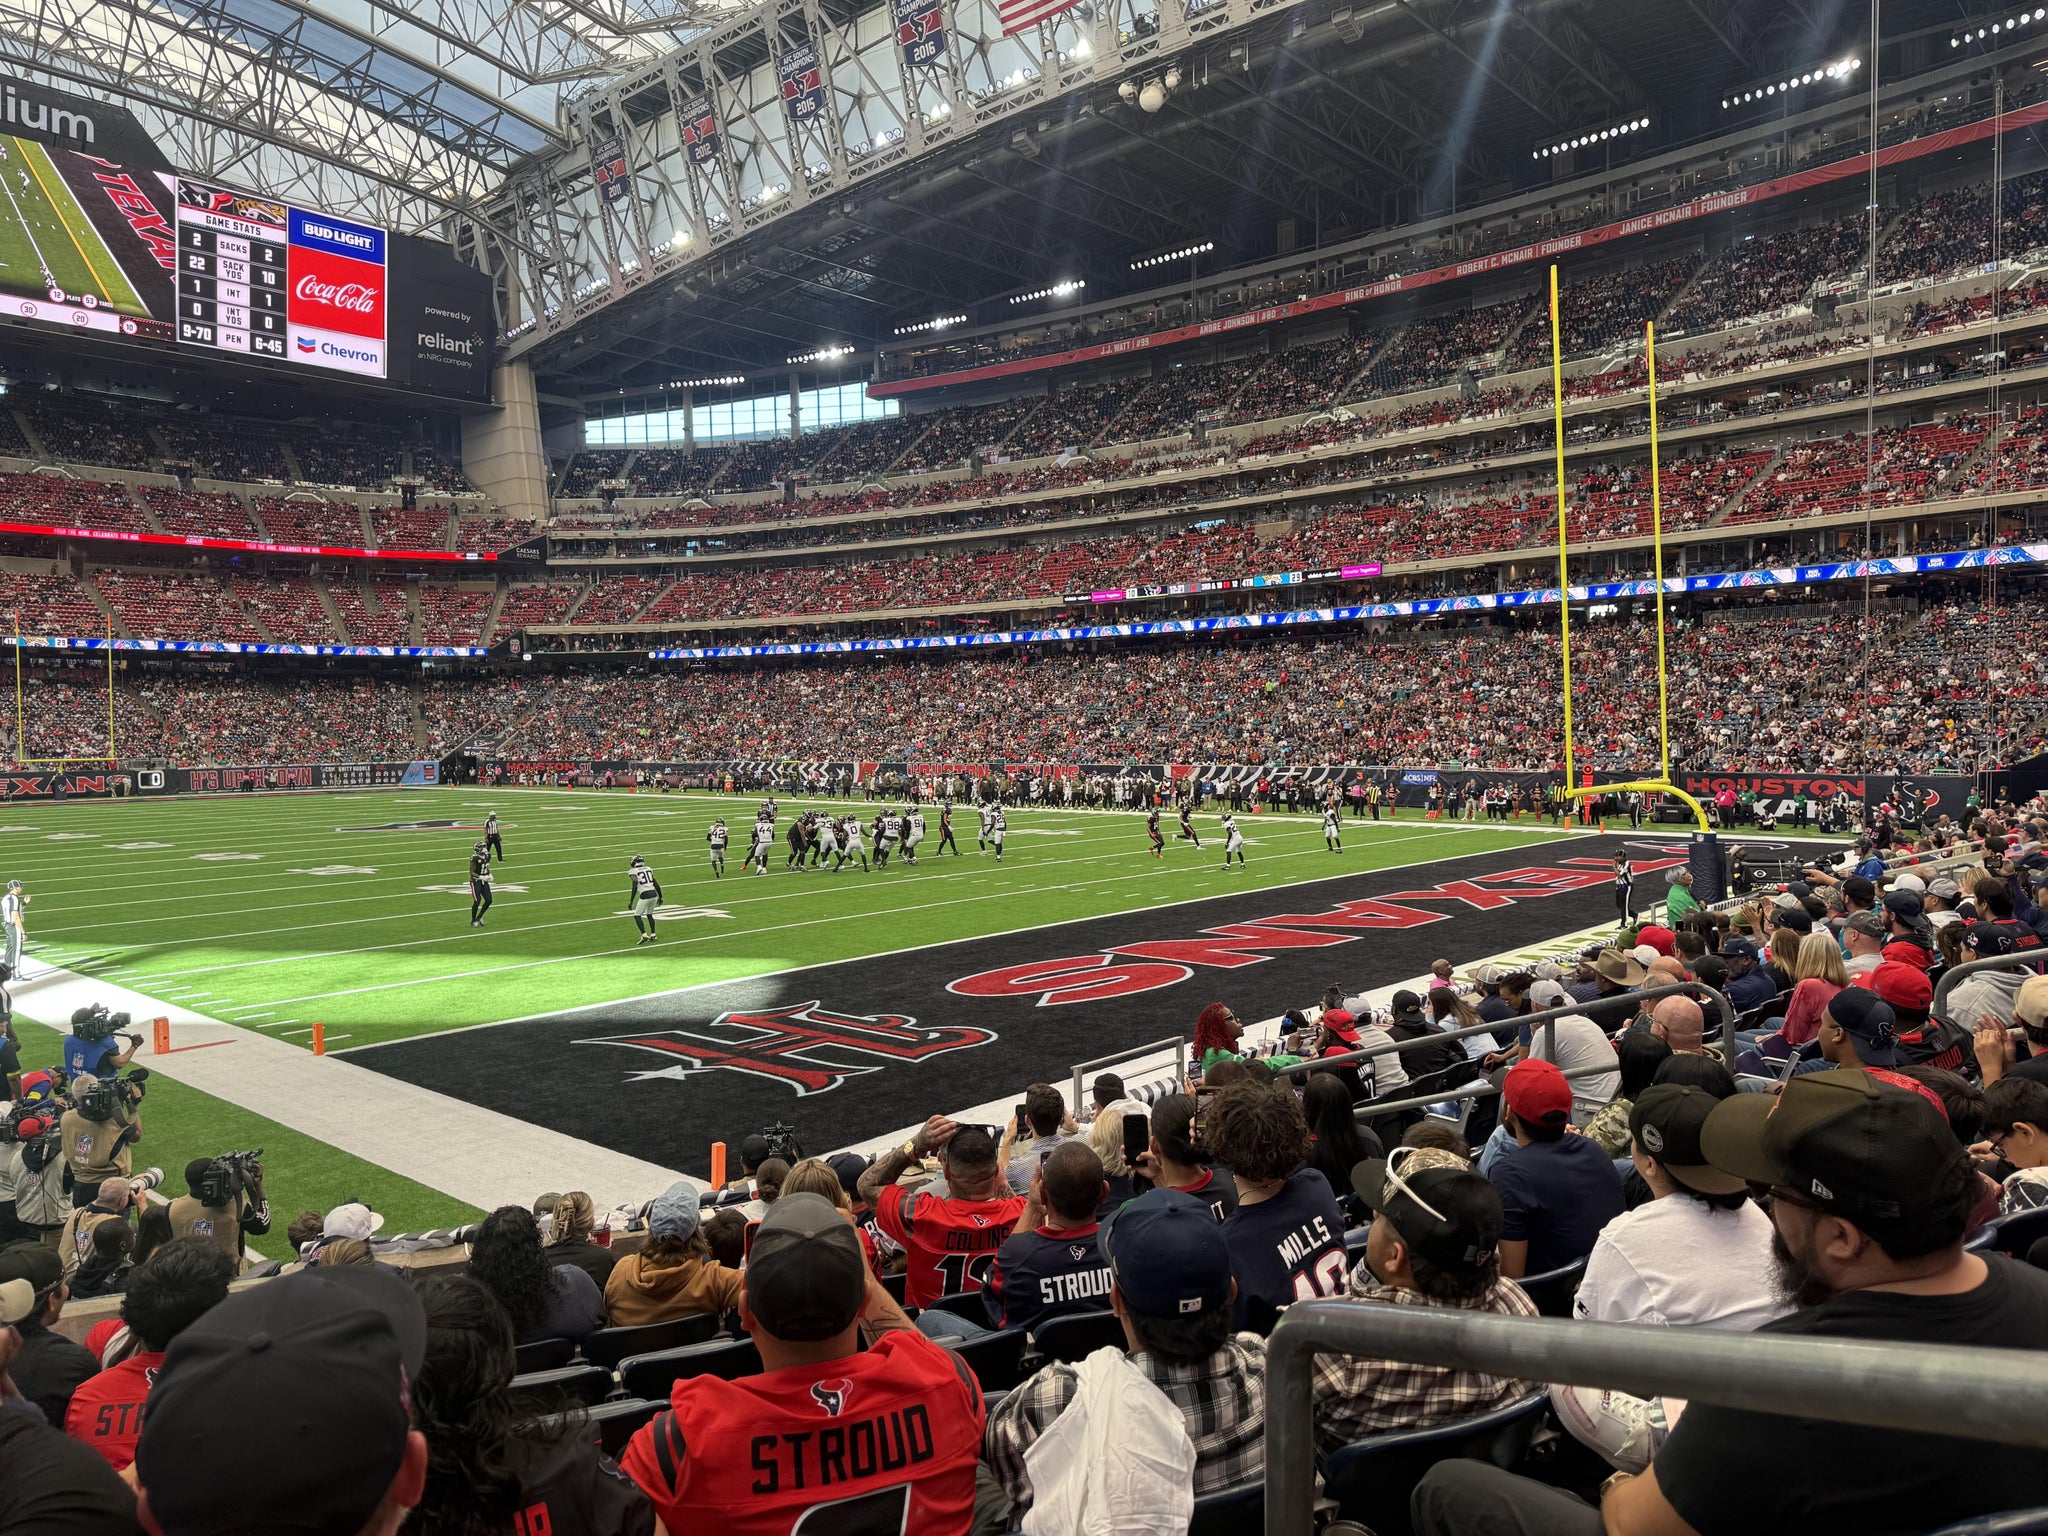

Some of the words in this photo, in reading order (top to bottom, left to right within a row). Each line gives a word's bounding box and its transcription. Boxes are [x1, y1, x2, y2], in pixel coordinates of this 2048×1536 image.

[914, 41, 936, 62] 2016
[781, 54, 814, 75] CHAMPIONS
[0, 82, 95, 143] ium
[796, 97, 816, 116] 2015
[694, 142, 712, 160] 2012
[608, 183, 622, 198] 2011
[1620, 216, 1652, 235] JANICE
[1656, 206, 1692, 226] MCNAIR
[1701, 191, 1747, 213] FOUNDER
[206, 215, 230, 228] GAME
[233, 222, 261, 236] STATS
[193, 232, 201, 246] 2
[304, 223, 334, 241] BUD
[334, 232, 372, 249] LIGHT
[220, 240, 247, 254] SACKS
[190, 255, 206, 270] 22
[265, 249, 273, 262] 2
[1456, 260, 1489, 276] ROBERT
[1490, 257, 1499, 268] C.
[1501, 248, 1533, 266] MCNAIR
[1541, 236, 1582, 254] FOUNDER
[223, 260, 244, 272] SACK
[226, 270, 242, 280] YDS
[262, 271, 276, 285] 10
[194, 280, 200, 292] 1
[226, 288, 241, 298] INT
[1345, 288, 1365, 301] RING
[1365, 287, 1372, 296] OF
[1373, 280, 1402, 296] HONOR
[54, 291, 62, 299] 12
[266, 294, 272, 307] 1
[296, 274, 378, 314] Coca-Cola
[193, 302, 202, 316] 0
[226, 306, 241, 316] INT
[425, 306, 460, 319] powered
[461, 312, 471, 323] by
[24, 306, 33, 314] 30
[76, 315, 85, 323] 20
[126, 323, 134, 331] 10
[226, 316, 242, 326] YDS
[265, 316, 273, 330] 0
[1200, 322, 1222, 334] ANDRE
[1223, 316, 1255, 329] JOHNSON
[183, 324, 212, 341] 9-70
[226, 334, 242, 344] PEN
[256, 337, 282, 354] 6-45
[418, 332, 473, 355] reliant
[1114, 341, 1130, 352] WATT
[1136, 338, 1149, 348] #99
[321, 342, 378, 364] Chevron
[426, 353, 442, 362] NRG
[443, 357, 472, 368] company
[152, 774, 160, 786] 0
[1687, 778, 1864, 797] HOUSTON
[760, 825, 772, 835] 44
[850, 826, 857, 835] 0
[888, 821, 900, 830] 98
[915, 819, 923, 828] 91
[712, 828, 725, 839] 42
[637, 870, 654, 884] 30
[2015, 935, 2041, 948] STROUD
[1277, 1215, 1331, 1270] MILLS
[1292, 1248, 1350, 1301] 10
[1039, 1266, 1115, 1304] STROUD
[751, 1403, 934, 1494] STROUD
